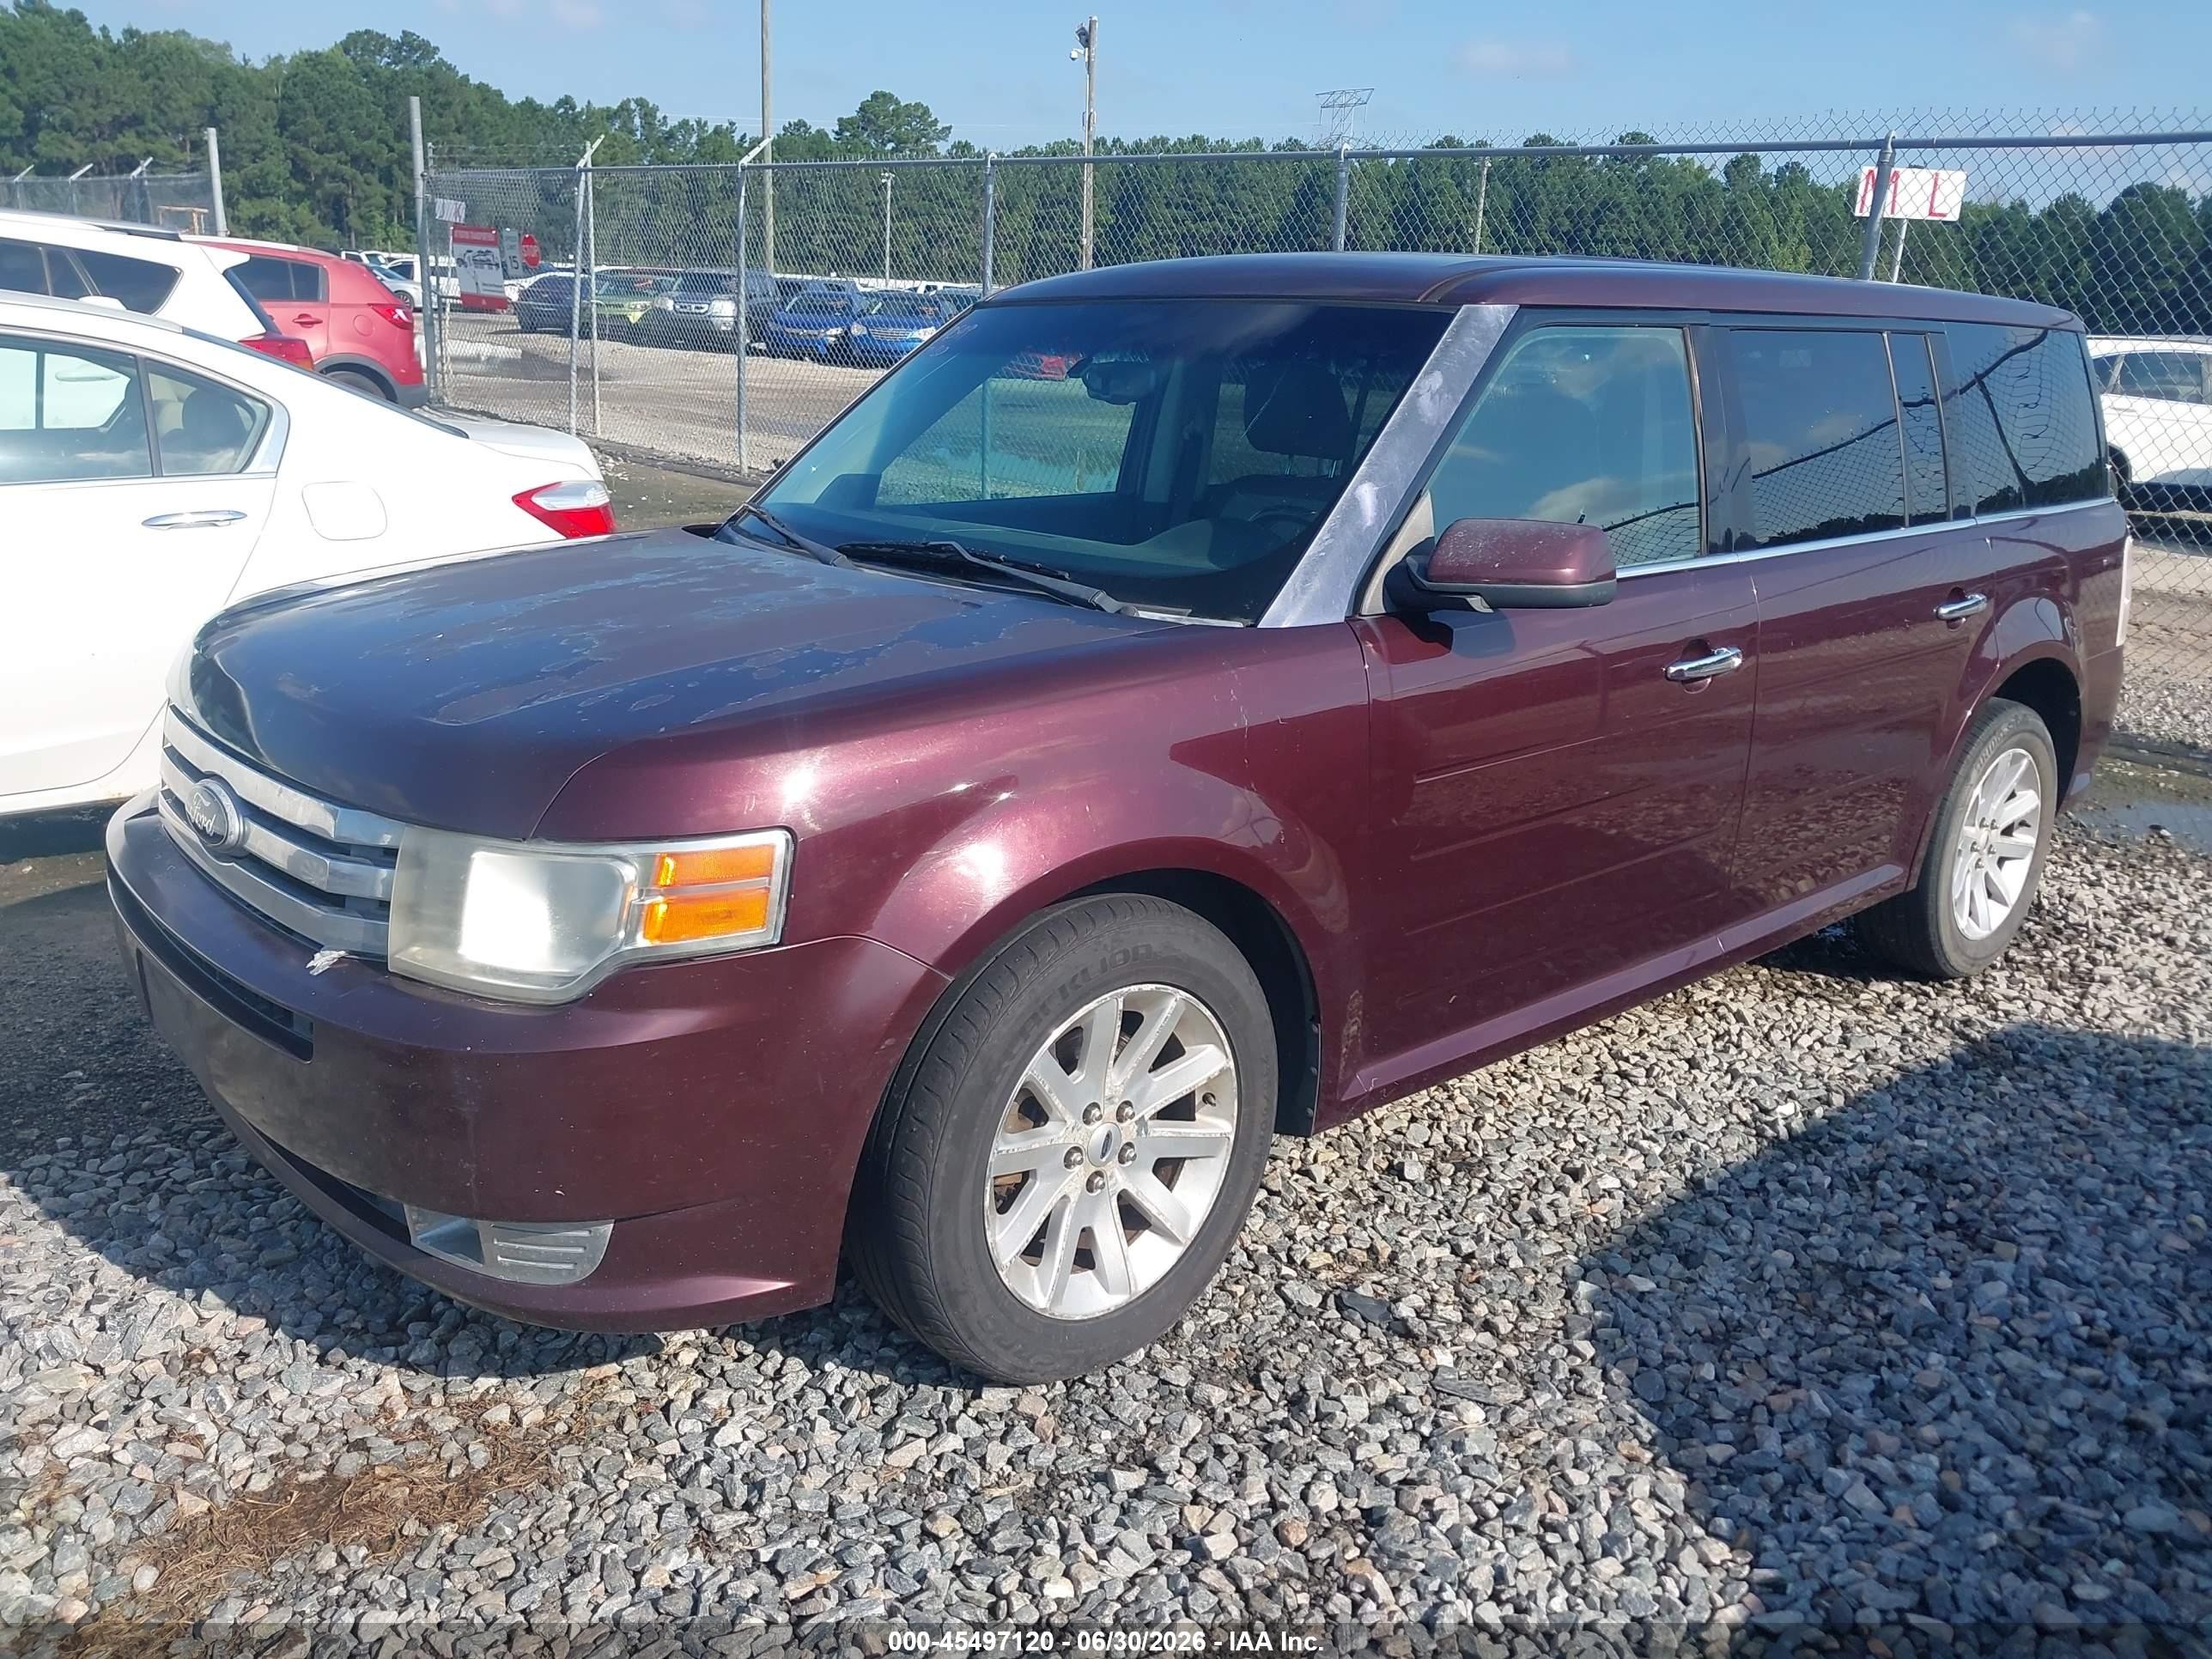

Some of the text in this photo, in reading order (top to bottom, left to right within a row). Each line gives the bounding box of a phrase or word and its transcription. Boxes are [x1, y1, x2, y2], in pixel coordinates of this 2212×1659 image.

[1928, 171, 1949, 217] L
[508, 255, 520, 270] 15
[521, 245, 539, 258] STOP
[191, 792, 217, 838] Ford
